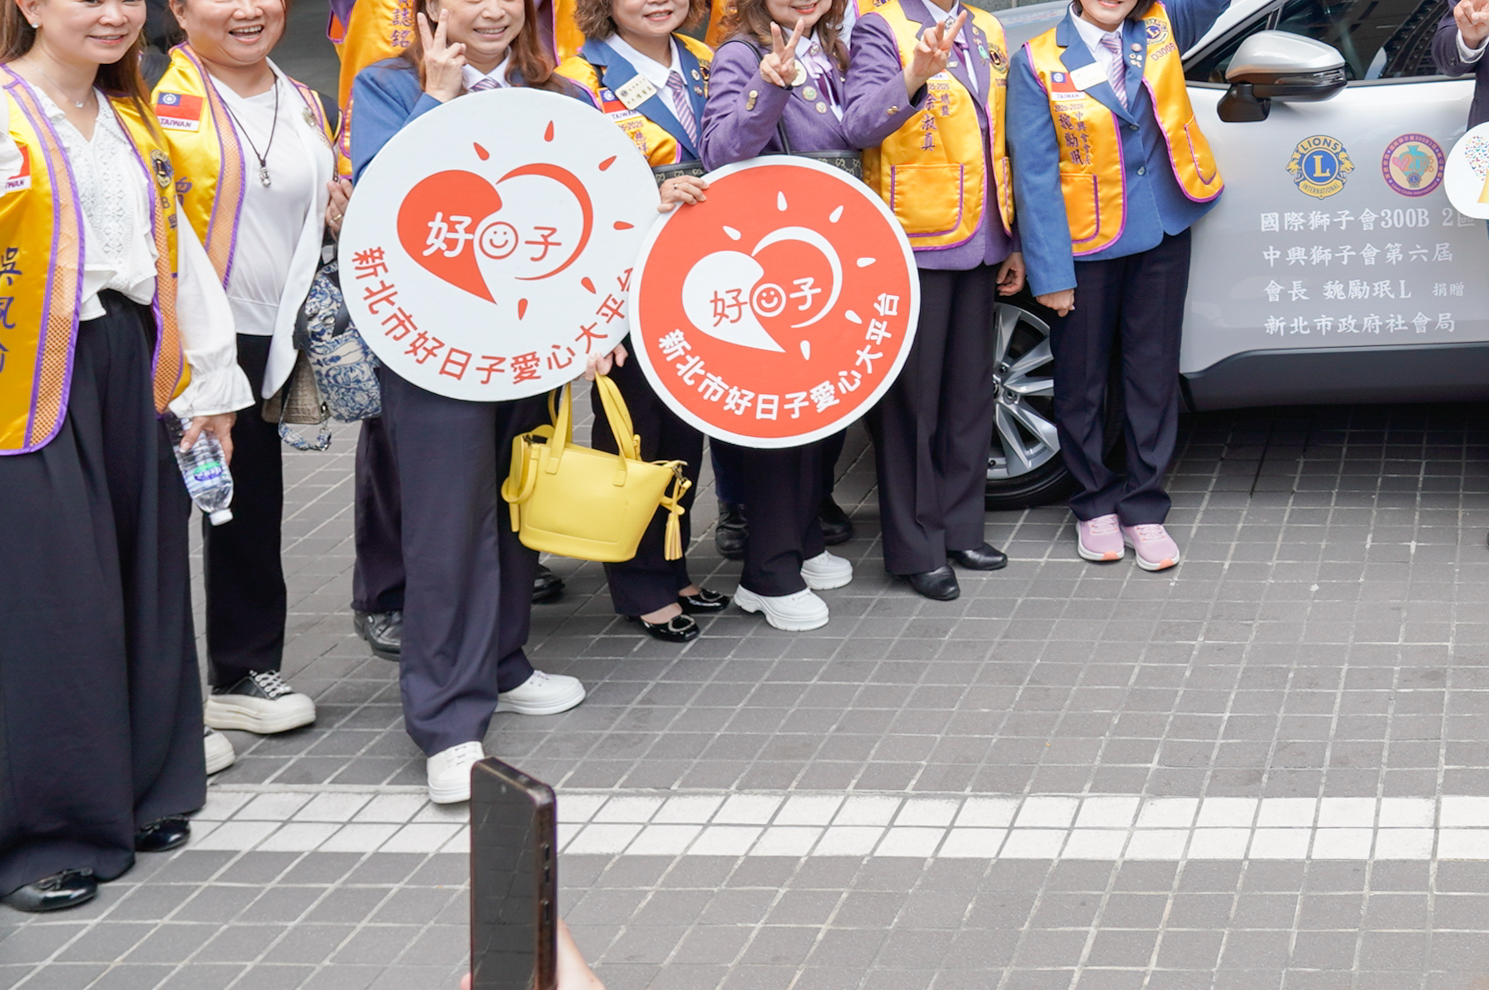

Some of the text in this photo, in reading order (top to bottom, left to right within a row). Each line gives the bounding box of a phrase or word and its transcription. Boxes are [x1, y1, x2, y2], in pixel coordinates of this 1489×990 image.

[160, 118, 192, 128] TAIWAN
[1300, 137, 1340, 152] LIONS
[1313, 155, 1331, 178] L
[1301, 183, 1341, 196] INTERNATIONAL
[1260, 207, 1430, 233] 國際獅子會300B
[1262, 242, 1453, 268] 中興獅子會第六屆
[1263, 279, 1310, 303] 會長
[1432, 281, 1465, 298] 捐贈
[1264, 311, 1456, 336] 新北市政府社會局
[658, 292, 900, 421] 新北市好日子愛心大平台
